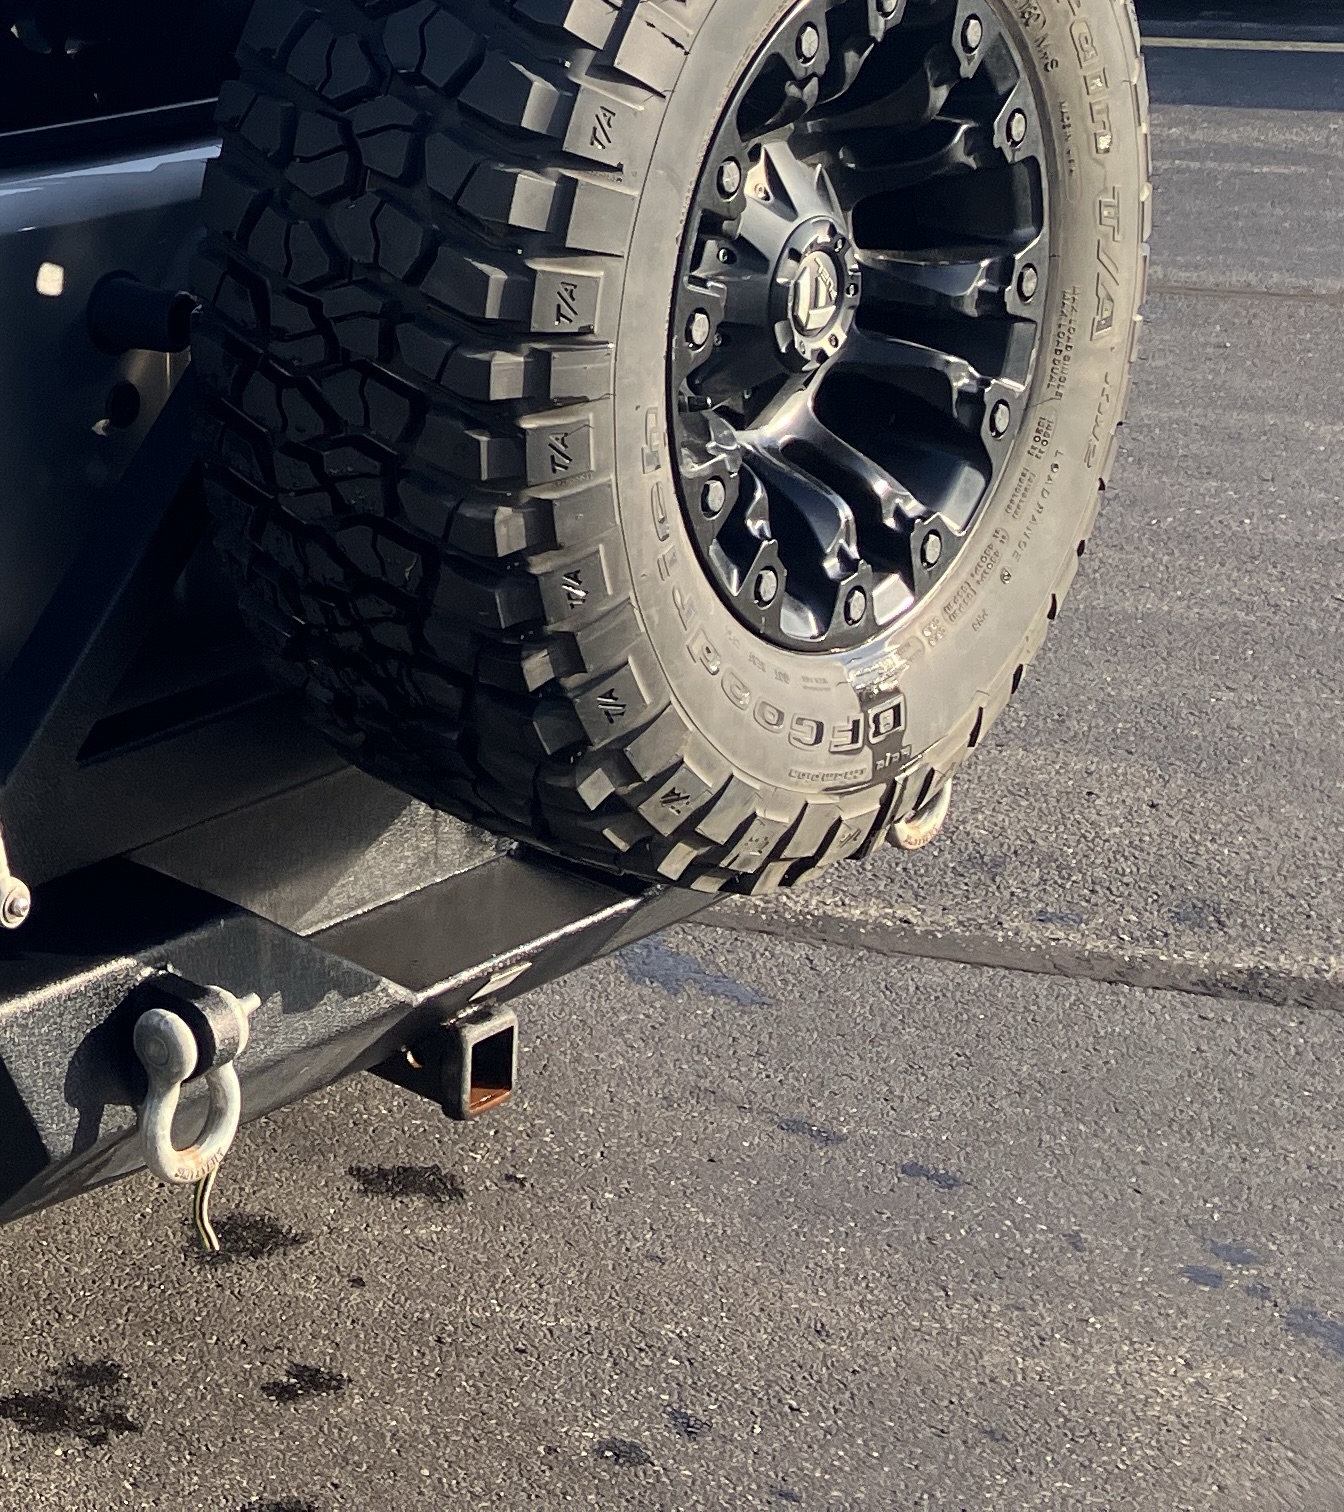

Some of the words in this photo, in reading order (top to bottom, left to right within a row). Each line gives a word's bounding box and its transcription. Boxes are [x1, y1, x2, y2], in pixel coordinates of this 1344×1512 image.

[590, 105, 616, 151] T/A
[555, 281, 578, 324] T/A
[550, 431, 574, 473] T/A
